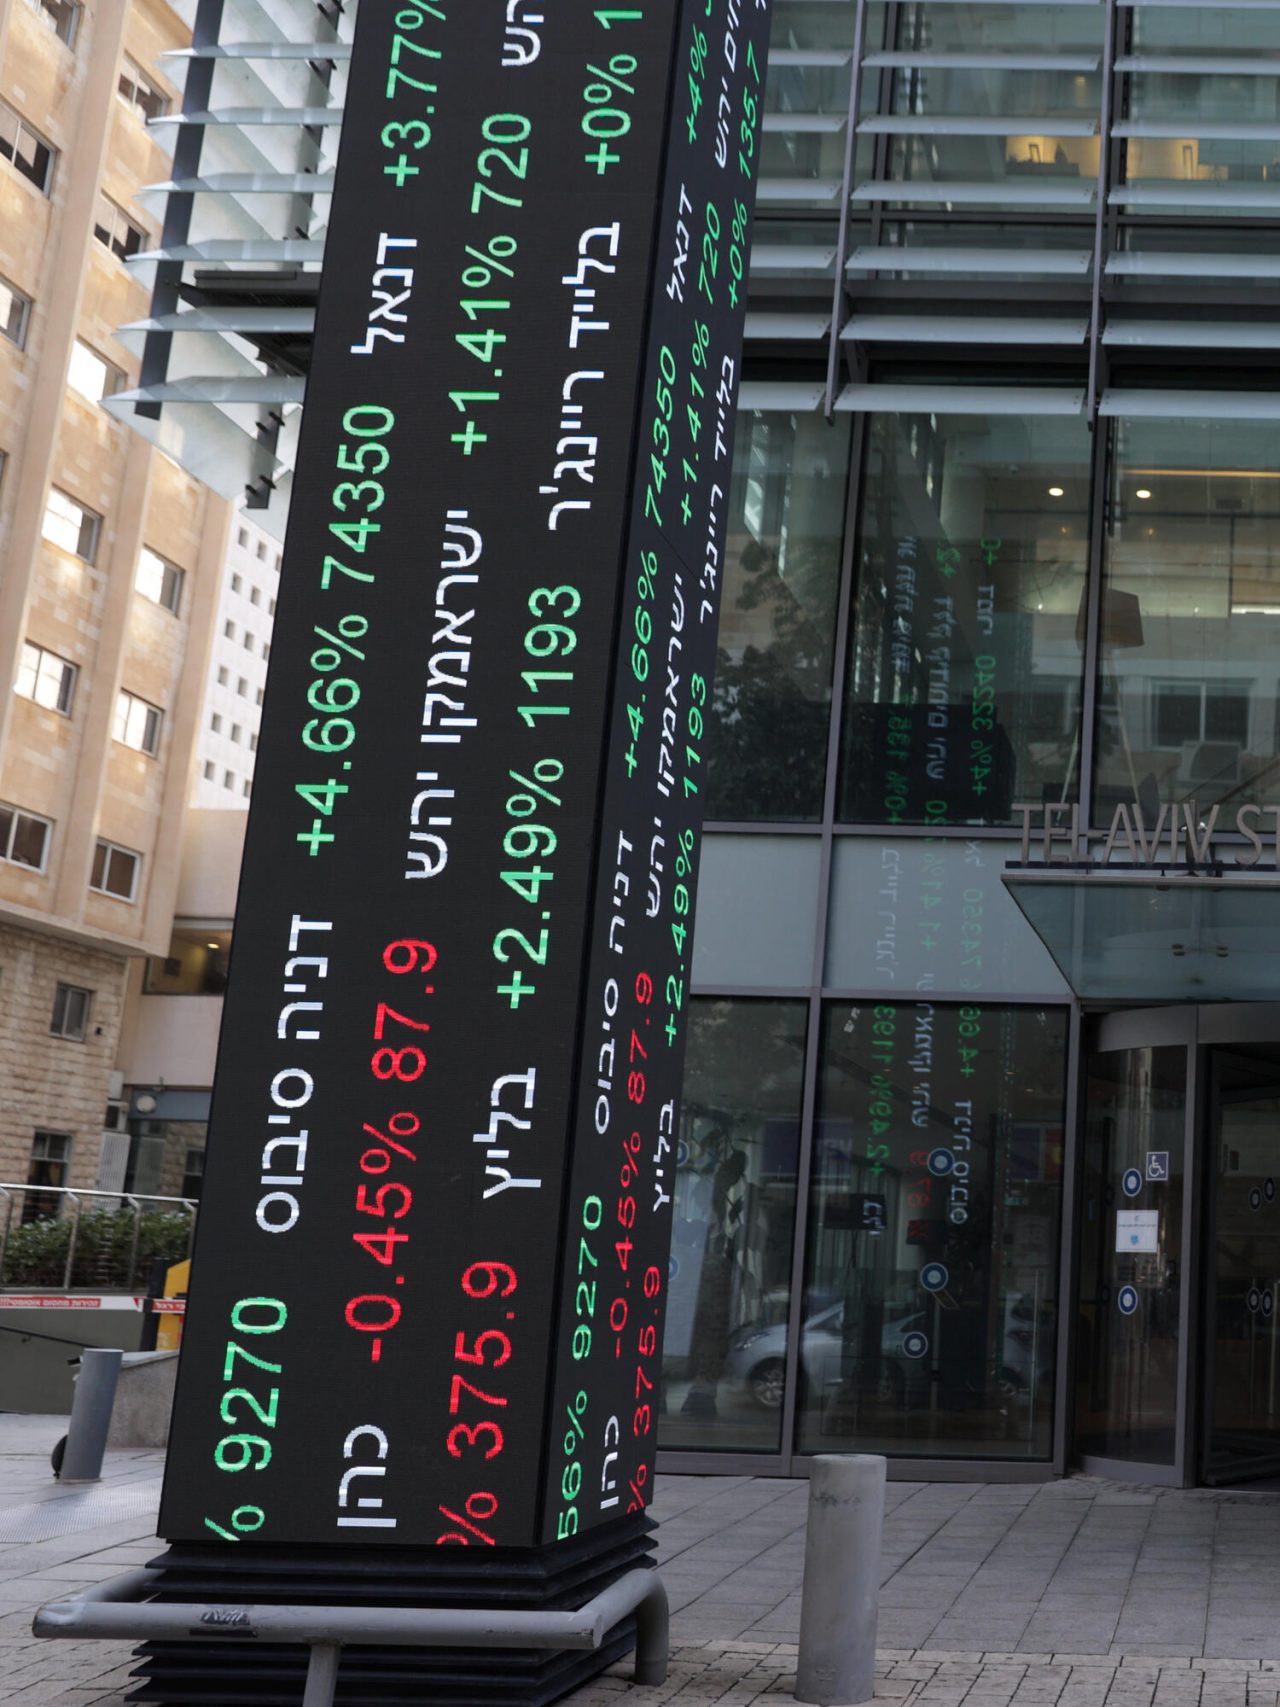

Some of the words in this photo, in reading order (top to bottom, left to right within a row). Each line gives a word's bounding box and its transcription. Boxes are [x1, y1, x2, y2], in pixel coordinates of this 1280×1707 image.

[501, 0, 545, 67] הש
[686, 24, 708, 144] +4%
[470, 112, 532, 214] 720
[581, 53, 638, 175] +0%
[714, 75, 732, 169] יהש
[728, 198, 748, 309] +0%
[738, 40, 760, 179] 135.7
[349, 232, 418, 355] דנאל
[561, 221, 621, 349] בלייד
[665, 182, 693, 304] דנאל
[448, 235, 518, 456] +1.41%
[680, 319, 710, 526] +1.41%
[698, 201, 721, 305] 720
[714, 354, 735, 462] בלייד
[320, 404, 395, 590] 74350
[624, 550, 658, 778] +4.66%
[644, 345, 676, 527] 74350
[420, 509, 483, 744] ישראמקו
[516, 584, 582, 728] 1193
[656, 572, 685, 798] ישראמקו
[294, 614, 369, 857] +4.66%
[404, 771, 456, 880] יהש
[492, 758, 565, 1009] +2.49%
[608, 829, 633, 955] דניה
[645, 816, 666, 918] יהש
[664, 828, 694, 1047] +2.49%
[683, 672, 706, 799] 1193
[1010, 802, 1095, 865] TEL
[1101, 802, 1220, 866] AVIV
[276, 914, 333, 1040] דניה
[370, 938, 439, 1082] 87.9
[594, 977, 619, 1135] סיבוס
[255, 1067, 315, 1234] סיבוס
[472, 1067, 542, 1200] בליץ
[609, 1131, 641, 1358] -0.45%
[627, 972, 653, 1105] 87.9
[652, 1099, 674, 1213] בליץ
[344, 1111, 421, 1362] -0.45%
[572, 1194, 603, 1361] 9270
[214, 1296, 288, 1473] 9270
[446, 1261, 518, 1460] 375.9
[633, 1265, 661, 1437] 375.9
[336, 1424, 397, 1528] כהן
